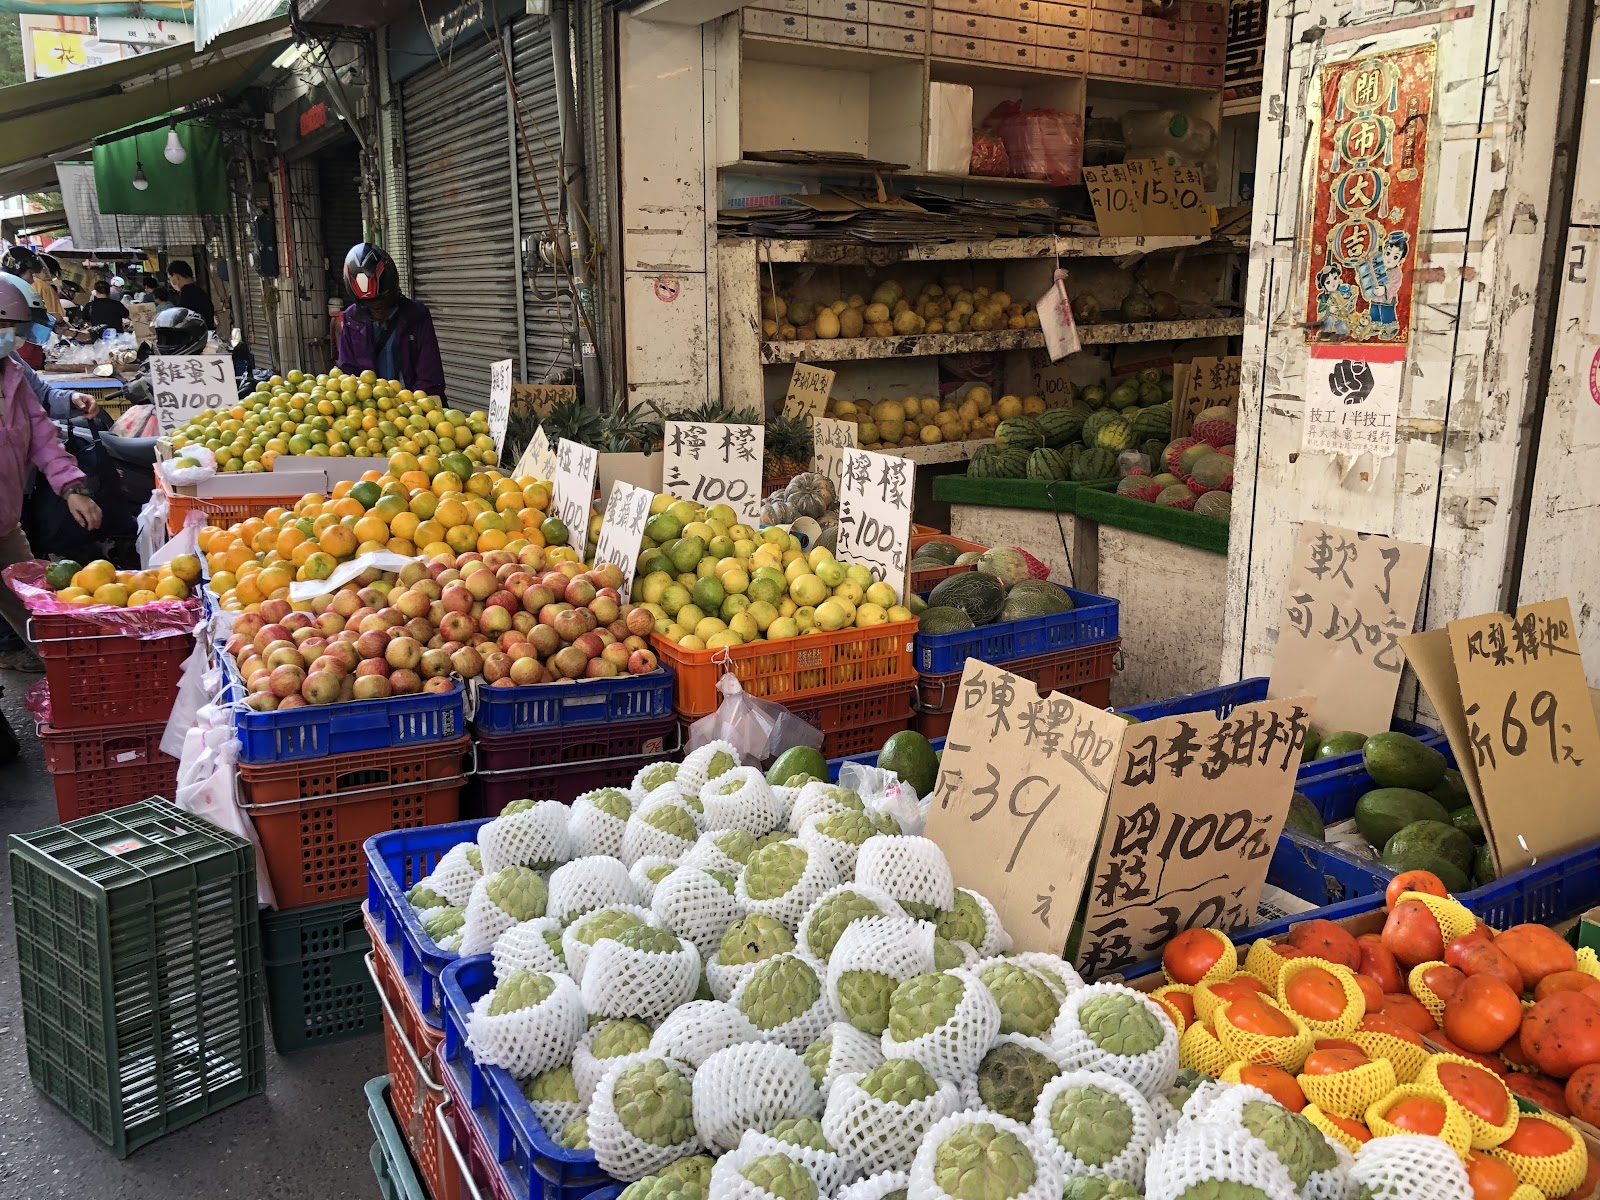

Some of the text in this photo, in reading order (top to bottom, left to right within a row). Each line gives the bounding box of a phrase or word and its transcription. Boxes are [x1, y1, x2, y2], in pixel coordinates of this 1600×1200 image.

[53, 42, 79, 66] 花
[1343, 69, 1381, 258] 開市大吉
[153, 359, 225, 386] 雞蛋丁
[667, 425, 758, 464] 檸檬
[843, 451, 908, 511] 檸檬
[1285, 592, 1407, 674] 可以吃
[964, 669, 1109, 796] 台東釋迦
